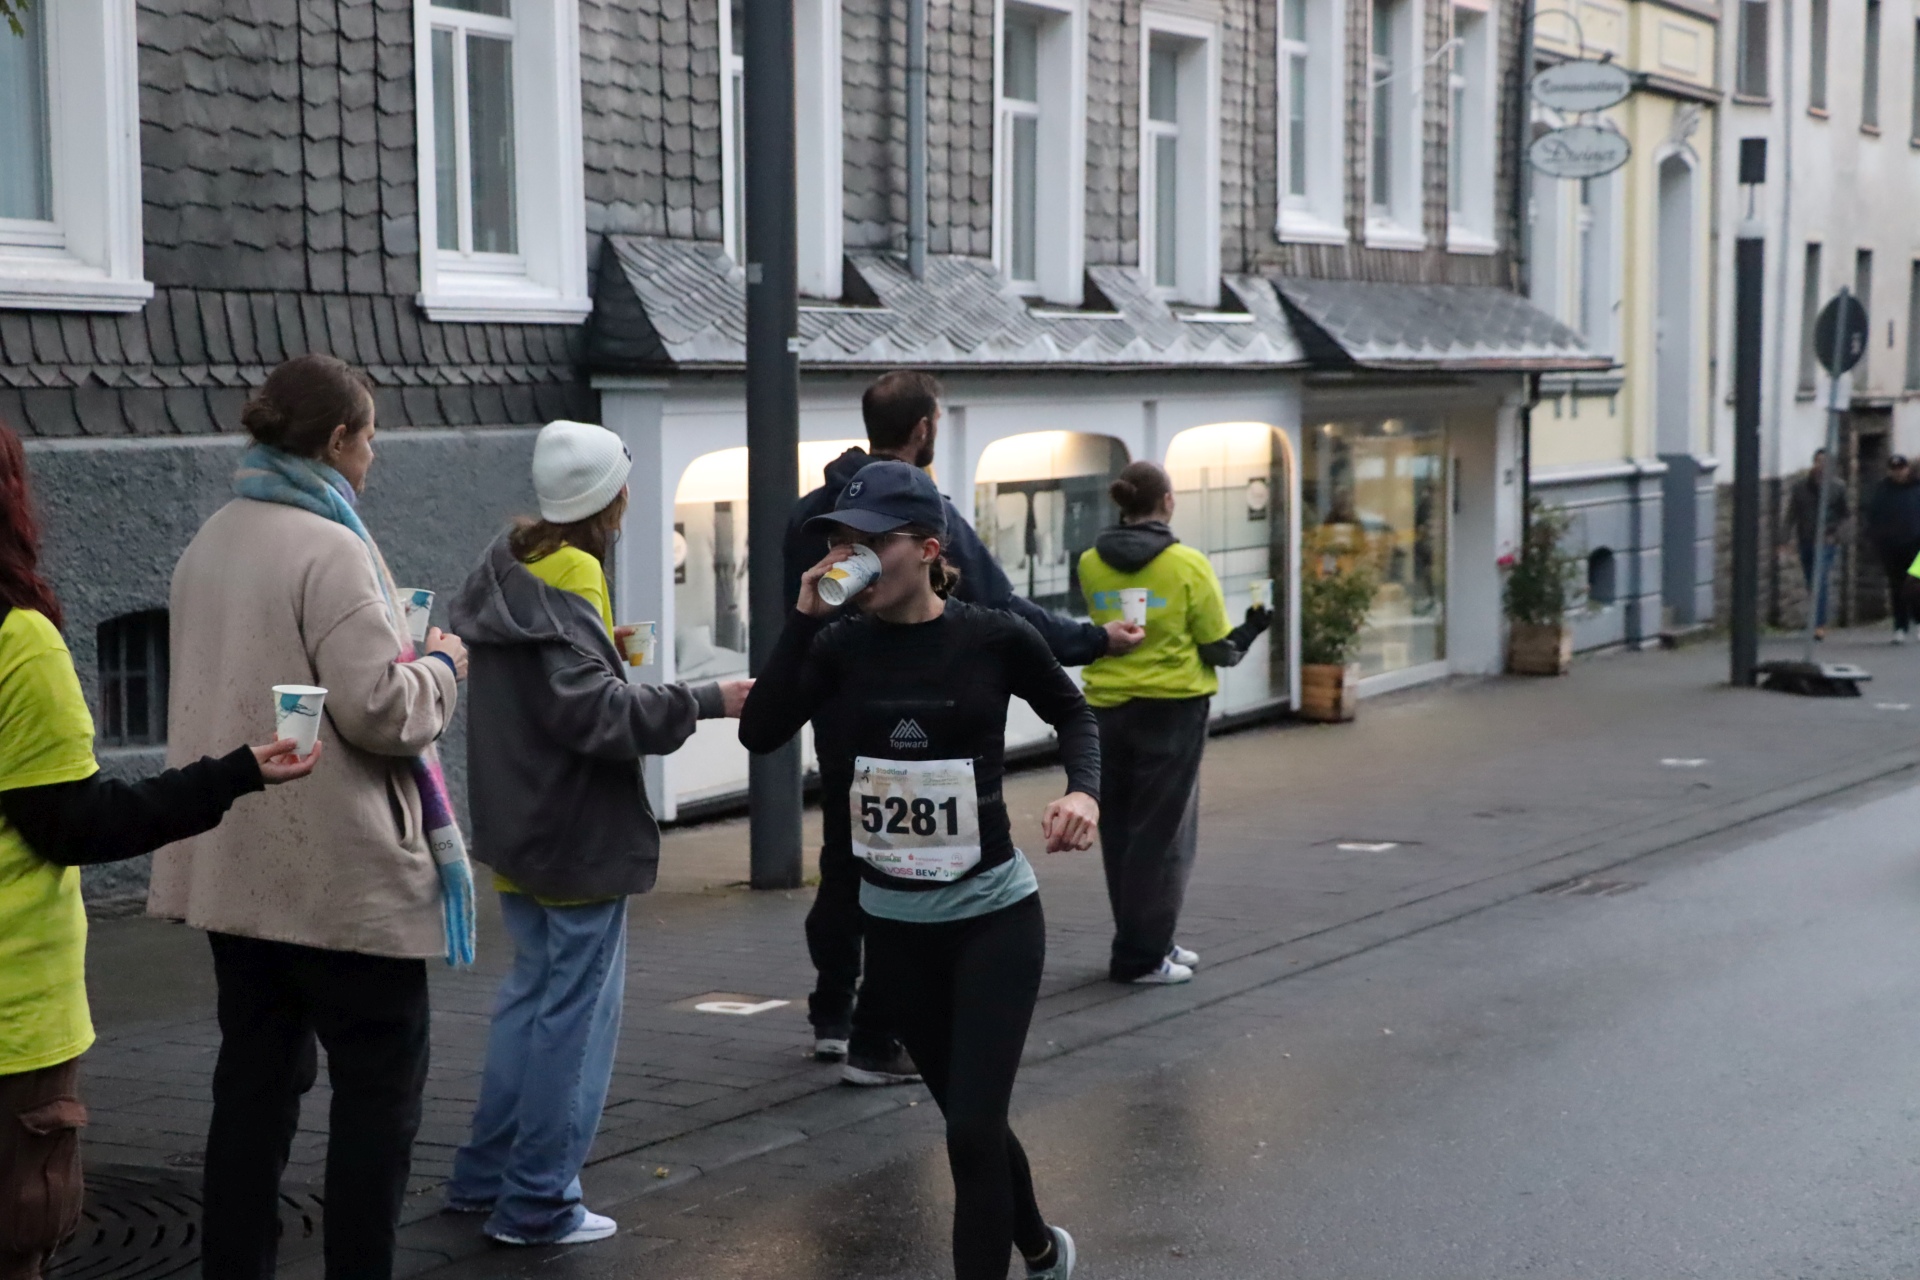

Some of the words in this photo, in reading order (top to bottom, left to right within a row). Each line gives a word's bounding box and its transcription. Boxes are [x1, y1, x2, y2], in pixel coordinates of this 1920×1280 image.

[890, 739, 928, 750] Topward
[876, 767, 908, 776] Stadtlauf
[861, 795, 958, 836] 5281
[434, 840, 454, 851] COS
[887, 867, 914, 876] VOSS
[915, 869, 938, 877] BEW
